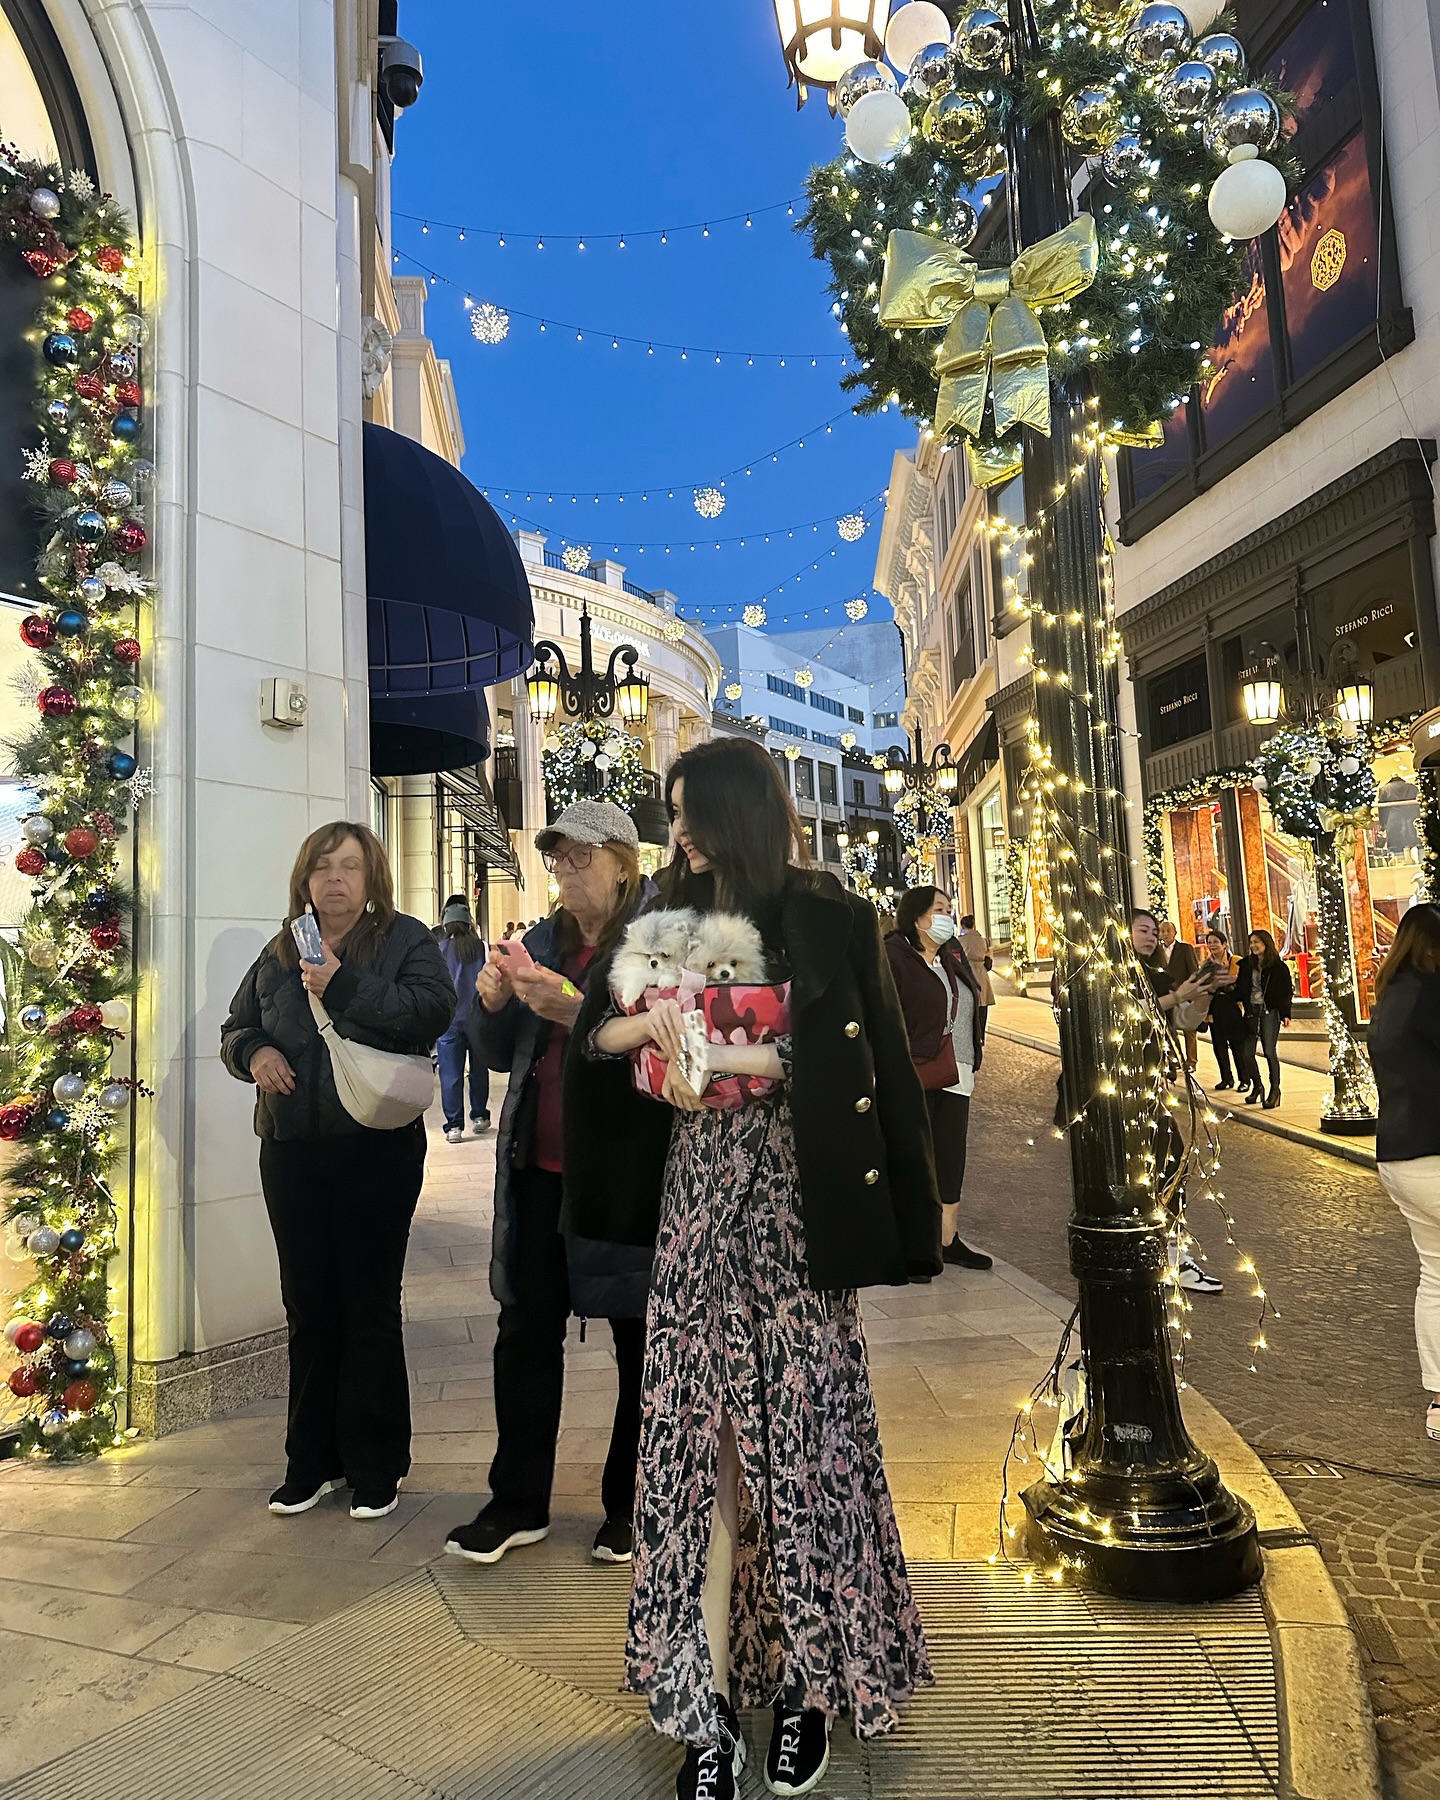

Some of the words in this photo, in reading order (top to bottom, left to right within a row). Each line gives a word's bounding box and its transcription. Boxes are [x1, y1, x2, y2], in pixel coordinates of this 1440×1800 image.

[1335, 616, 1369, 637] STEFANO
[1371, 604, 1394, 621] RICCI
[1160, 700, 1182, 715] STEFANO
[1183, 692, 1198, 704] RICCI
